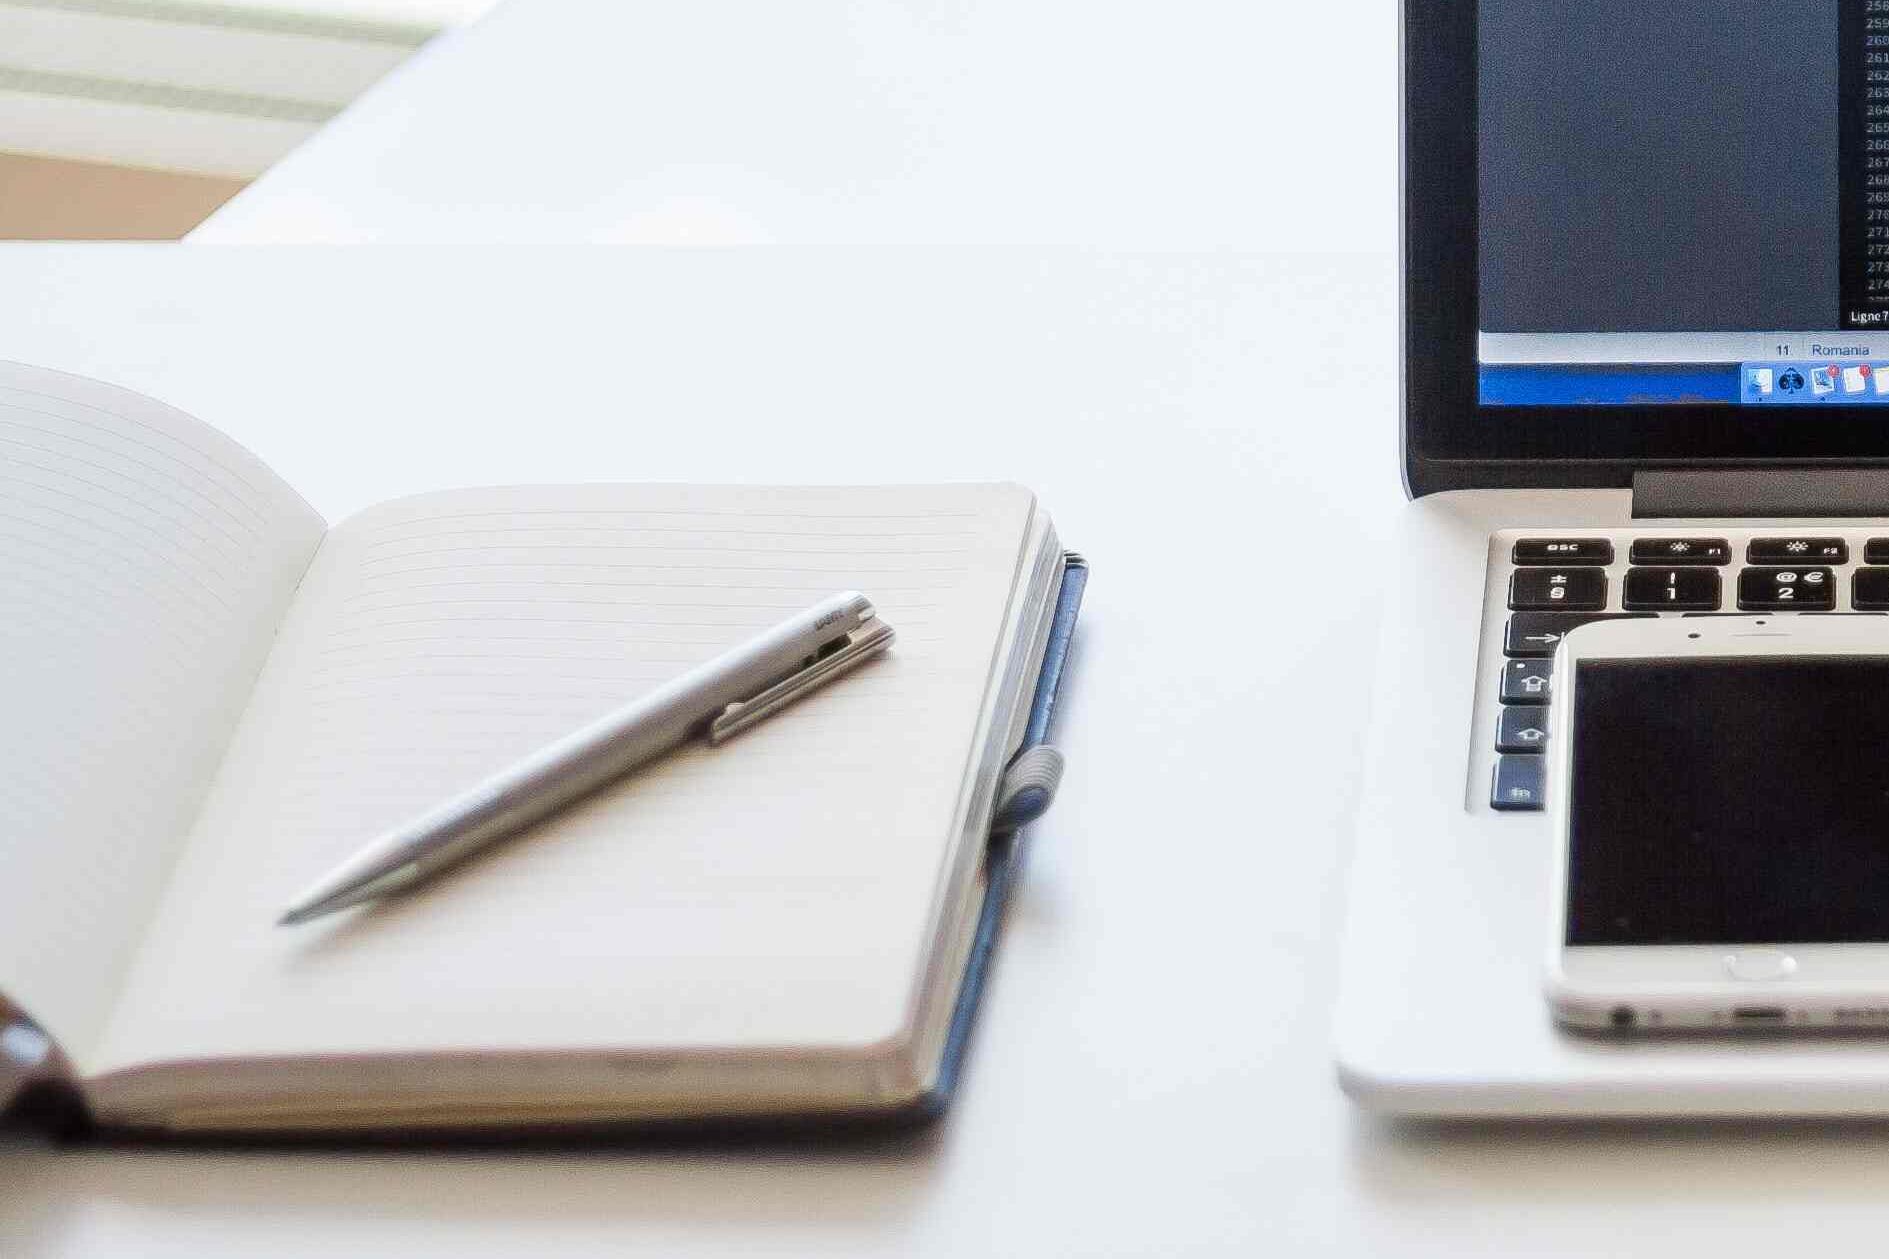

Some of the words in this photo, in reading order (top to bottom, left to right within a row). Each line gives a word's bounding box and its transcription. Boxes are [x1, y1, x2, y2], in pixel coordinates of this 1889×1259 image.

[1851, 312, 1880, 324] Ligne
[1777, 345, 1788, 355] 11
[1812, 344, 1869, 355] Romania
[1667, 588, 1675, 599] 1
[1779, 588, 1793, 599] 2
